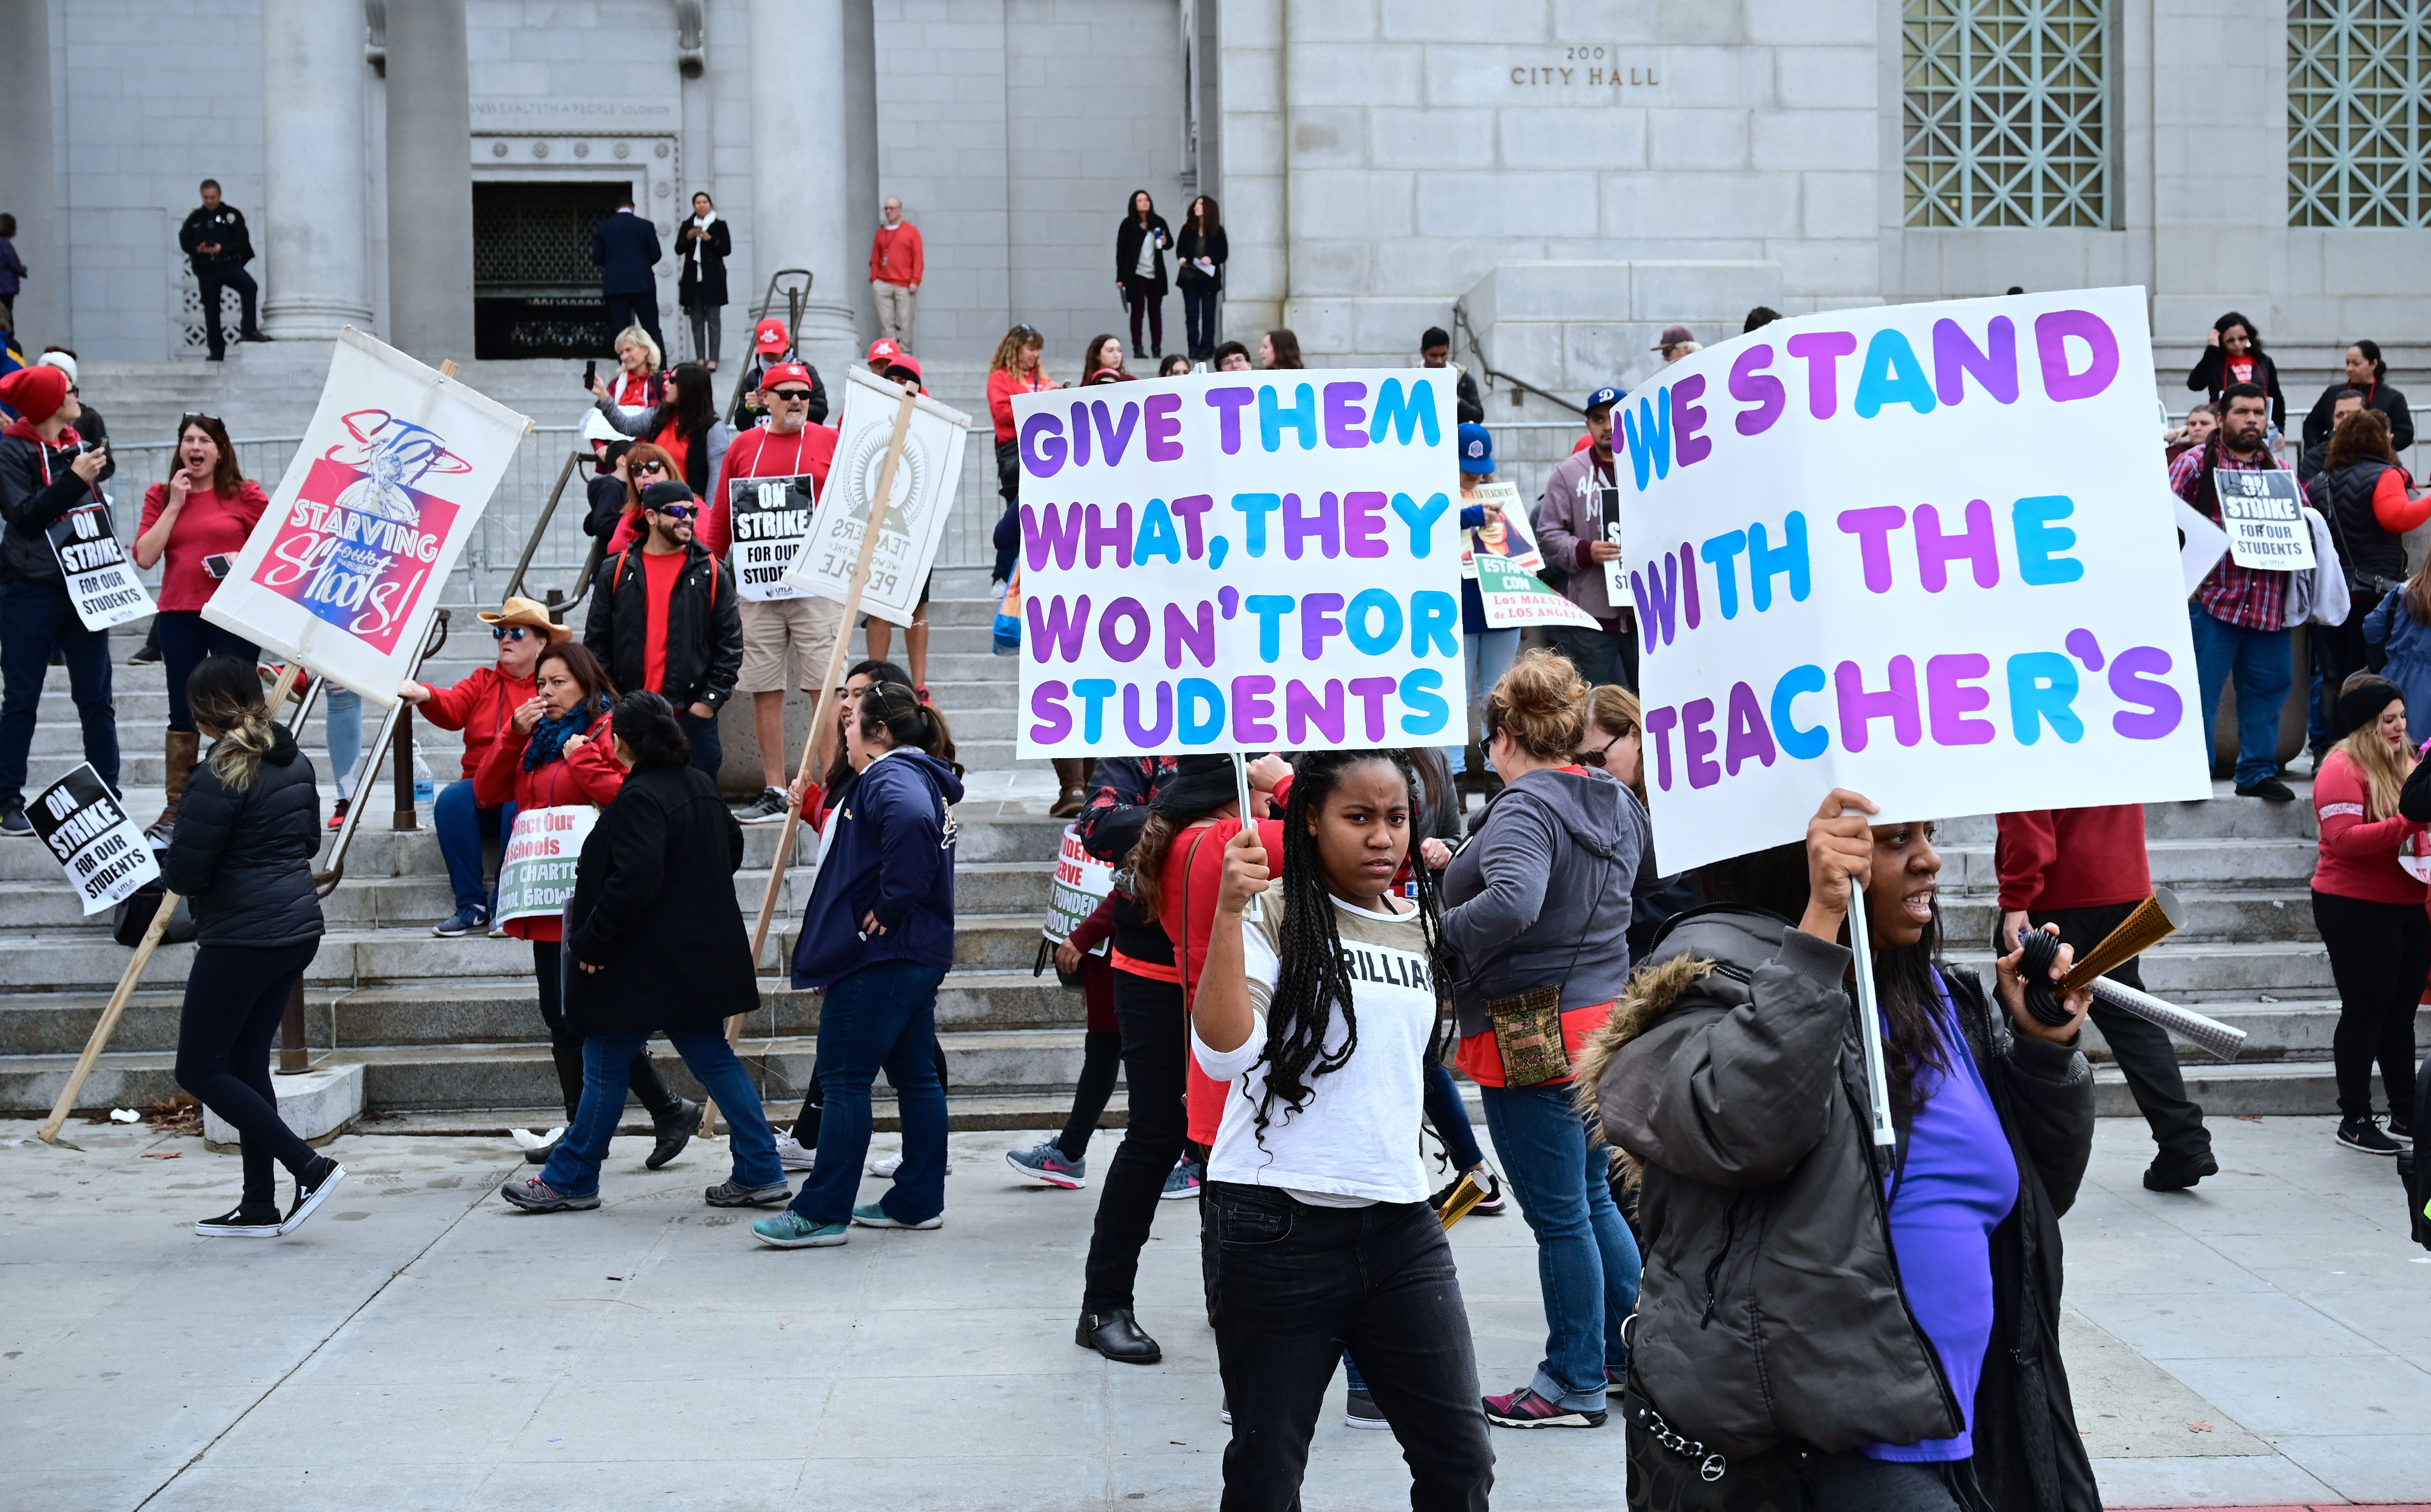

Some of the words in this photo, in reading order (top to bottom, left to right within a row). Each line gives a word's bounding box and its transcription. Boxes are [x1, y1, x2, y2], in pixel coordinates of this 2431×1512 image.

[1567, 47, 1604, 60] 200
[1511, 67, 1573, 85] CITY
[1590, 67, 1659, 85] HALL
[573, 103, 615, 114] PEOPLE
[1728, 309, 2120, 436] STAND
[1020, 393, 1184, 478] GIVE
[1205, 378, 1441, 455] THEM
[758, 483, 786, 509] ON
[2241, 475, 2270, 496] ON
[2226, 496, 2296, 519] STRIKE
[72, 511, 99, 539] ON
[290, 499, 438, 563] STARVING
[737, 509, 808, 539] STRIKE
[2240, 524, 2263, 538] FOR
[2266, 526, 2292, 538] OUR
[61, 537, 122, 572] STRIKE
[748, 546, 770, 563] FOR
[2238, 541, 2302, 555] STUDENTS
[79, 577, 101, 594] FOR
[100, 571, 125, 588] OUR
[744, 566, 788, 584] STUDE
[1502, 576, 1531, 590] CON
[1630, 510, 1811, 655] WITH
[1836, 495, 2085, 593] THE
[83, 588, 141, 614] STUDENTS
[1508, 608, 1533, 618] LOS
[1030, 668, 1449, 748] STUDENTS
[1645, 628, 2183, 792] TEACHER'S
[46, 785, 79, 821] ON
[49, 797, 120, 859] STRIKE
[544, 813, 575, 831] Our
[75, 853, 98, 878] FOR
[94, 834, 127, 860] OUR
[509, 837, 560, 864] Schools
[85, 848, 146, 899] STUDENTS
[117, 879, 135, 892] UTLA
[520, 862, 578, 883] CHARTE
